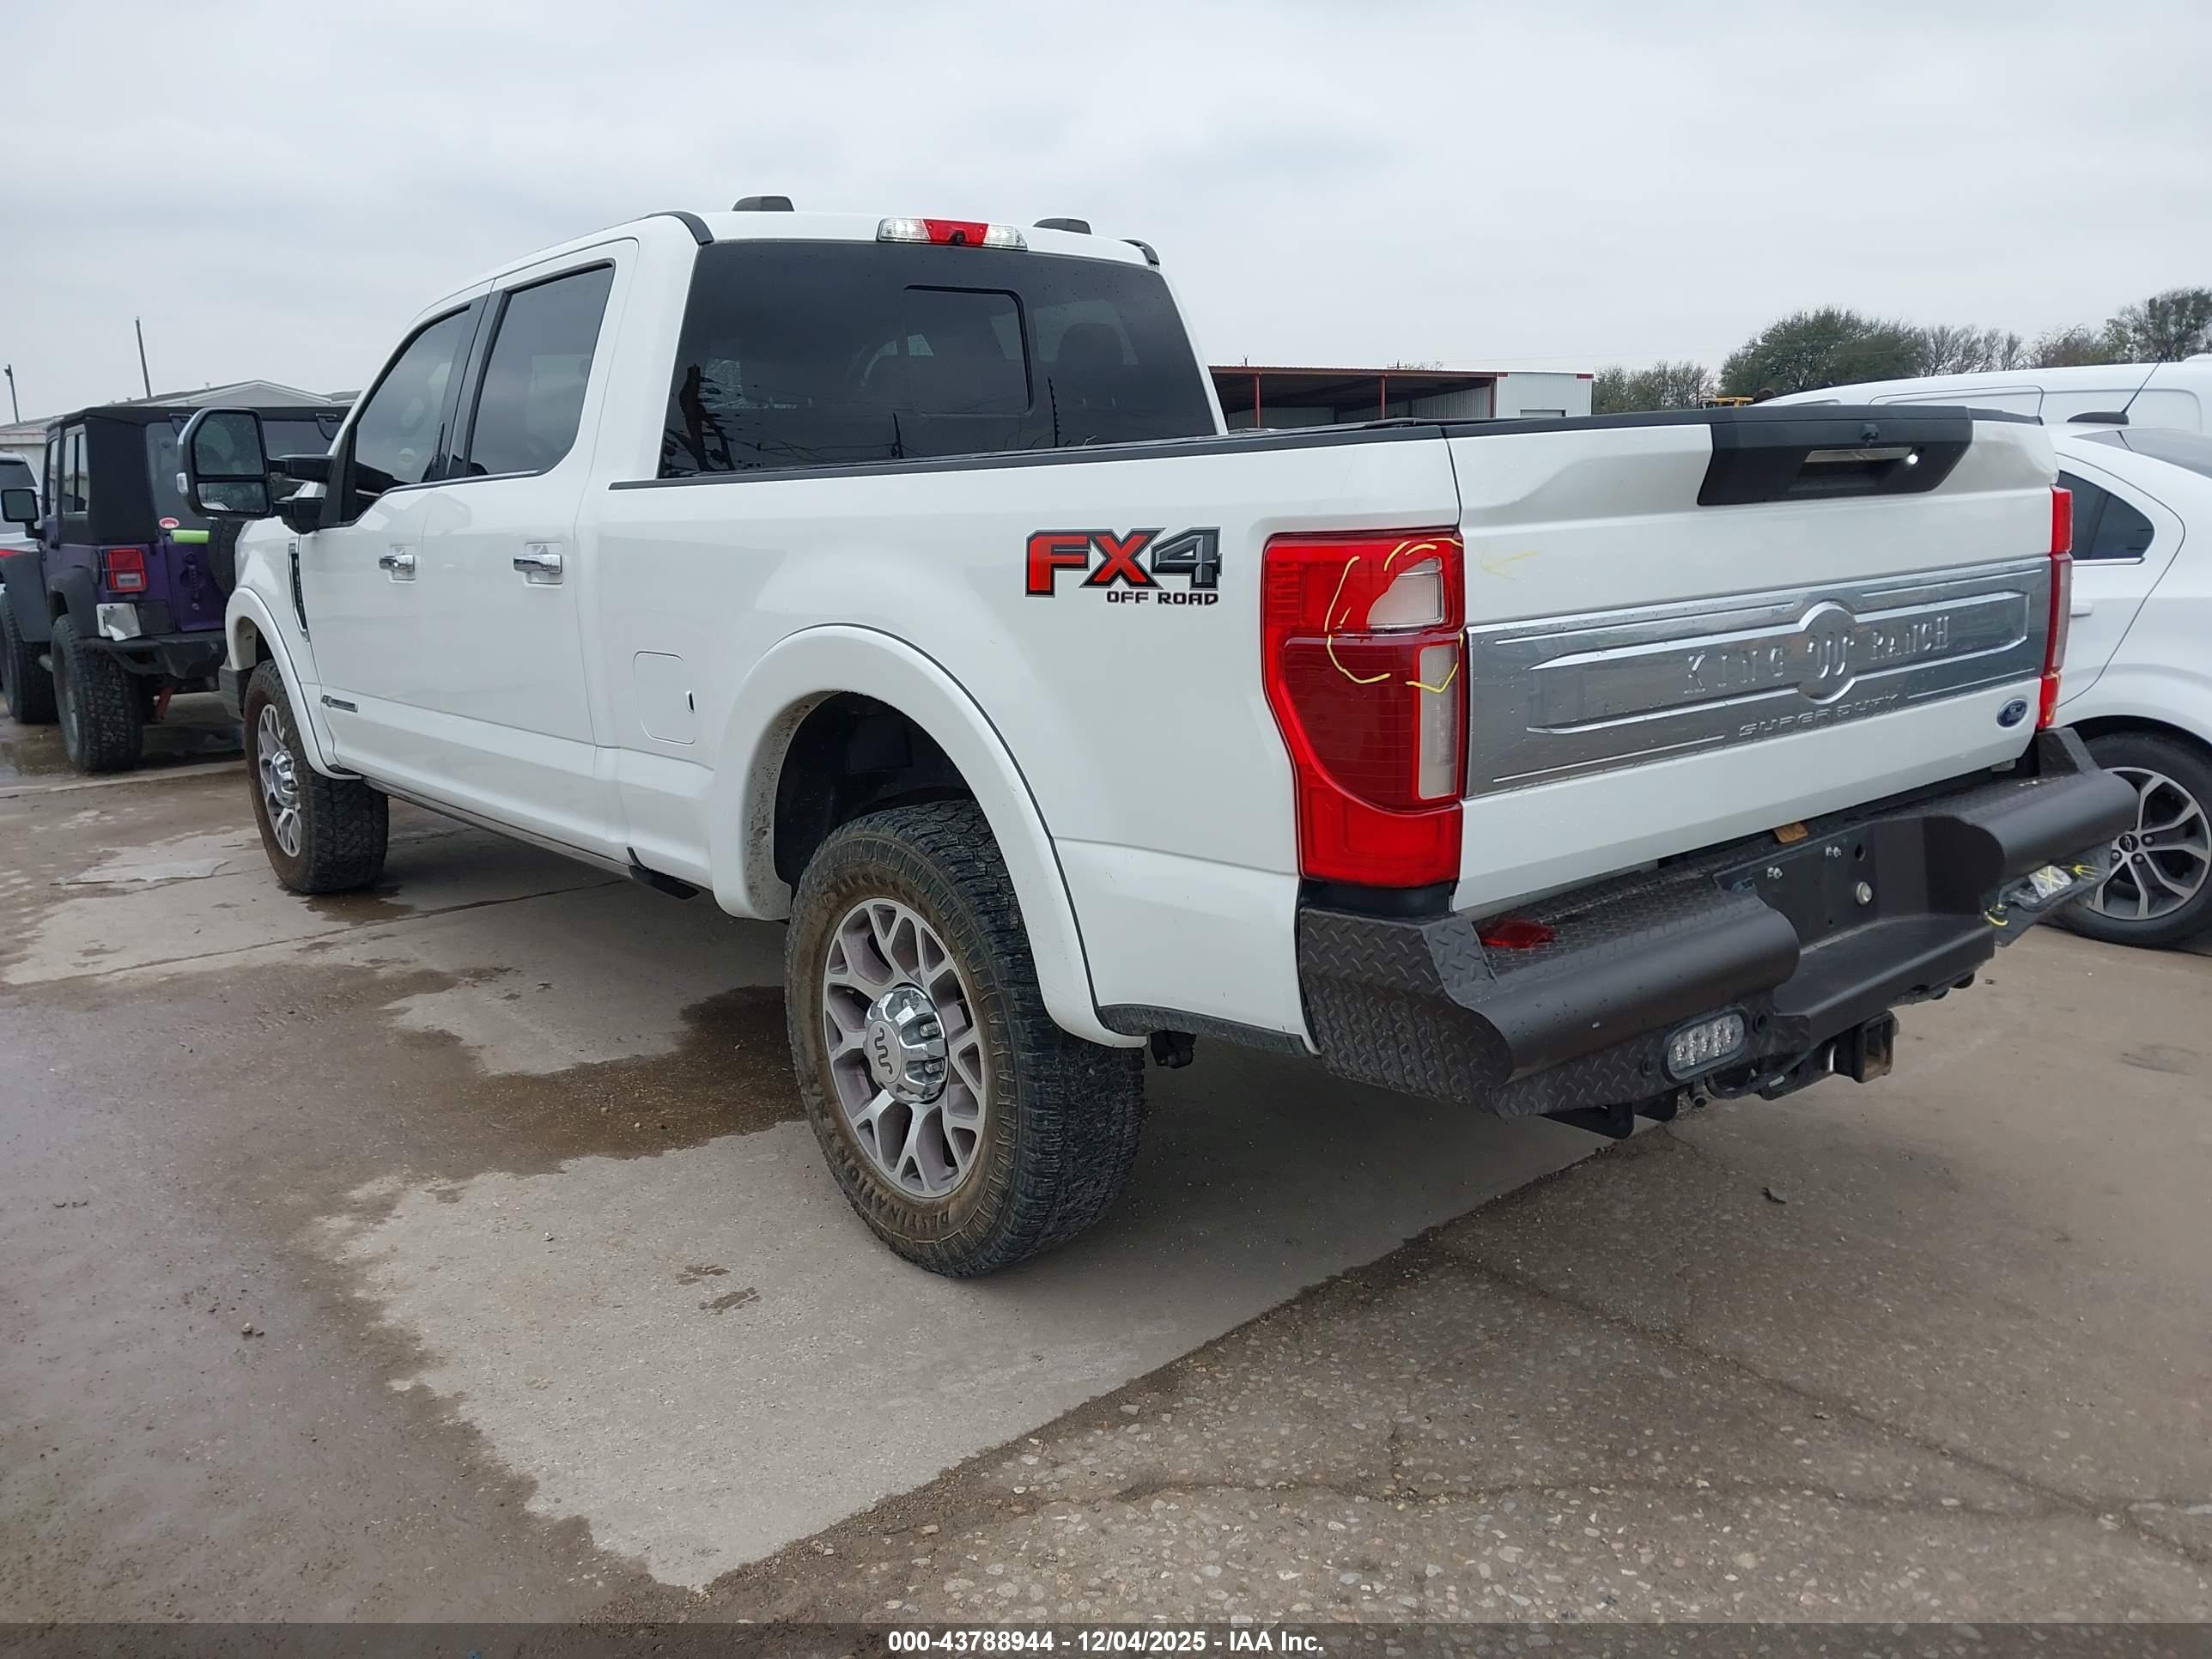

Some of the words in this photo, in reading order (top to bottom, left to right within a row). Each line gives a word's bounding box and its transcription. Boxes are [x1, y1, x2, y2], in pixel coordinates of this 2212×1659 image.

[1025, 526, 1223, 597] FX4
[1106, 591, 1149, 604] OFF
[1157, 592, 1218, 605] ROAD
[1684, 647, 1784, 695] KING
[1870, 616, 1950, 660] RANCH
[1738, 708, 1831, 737] SUPER
[1838, 694, 1899, 715] DUTY
